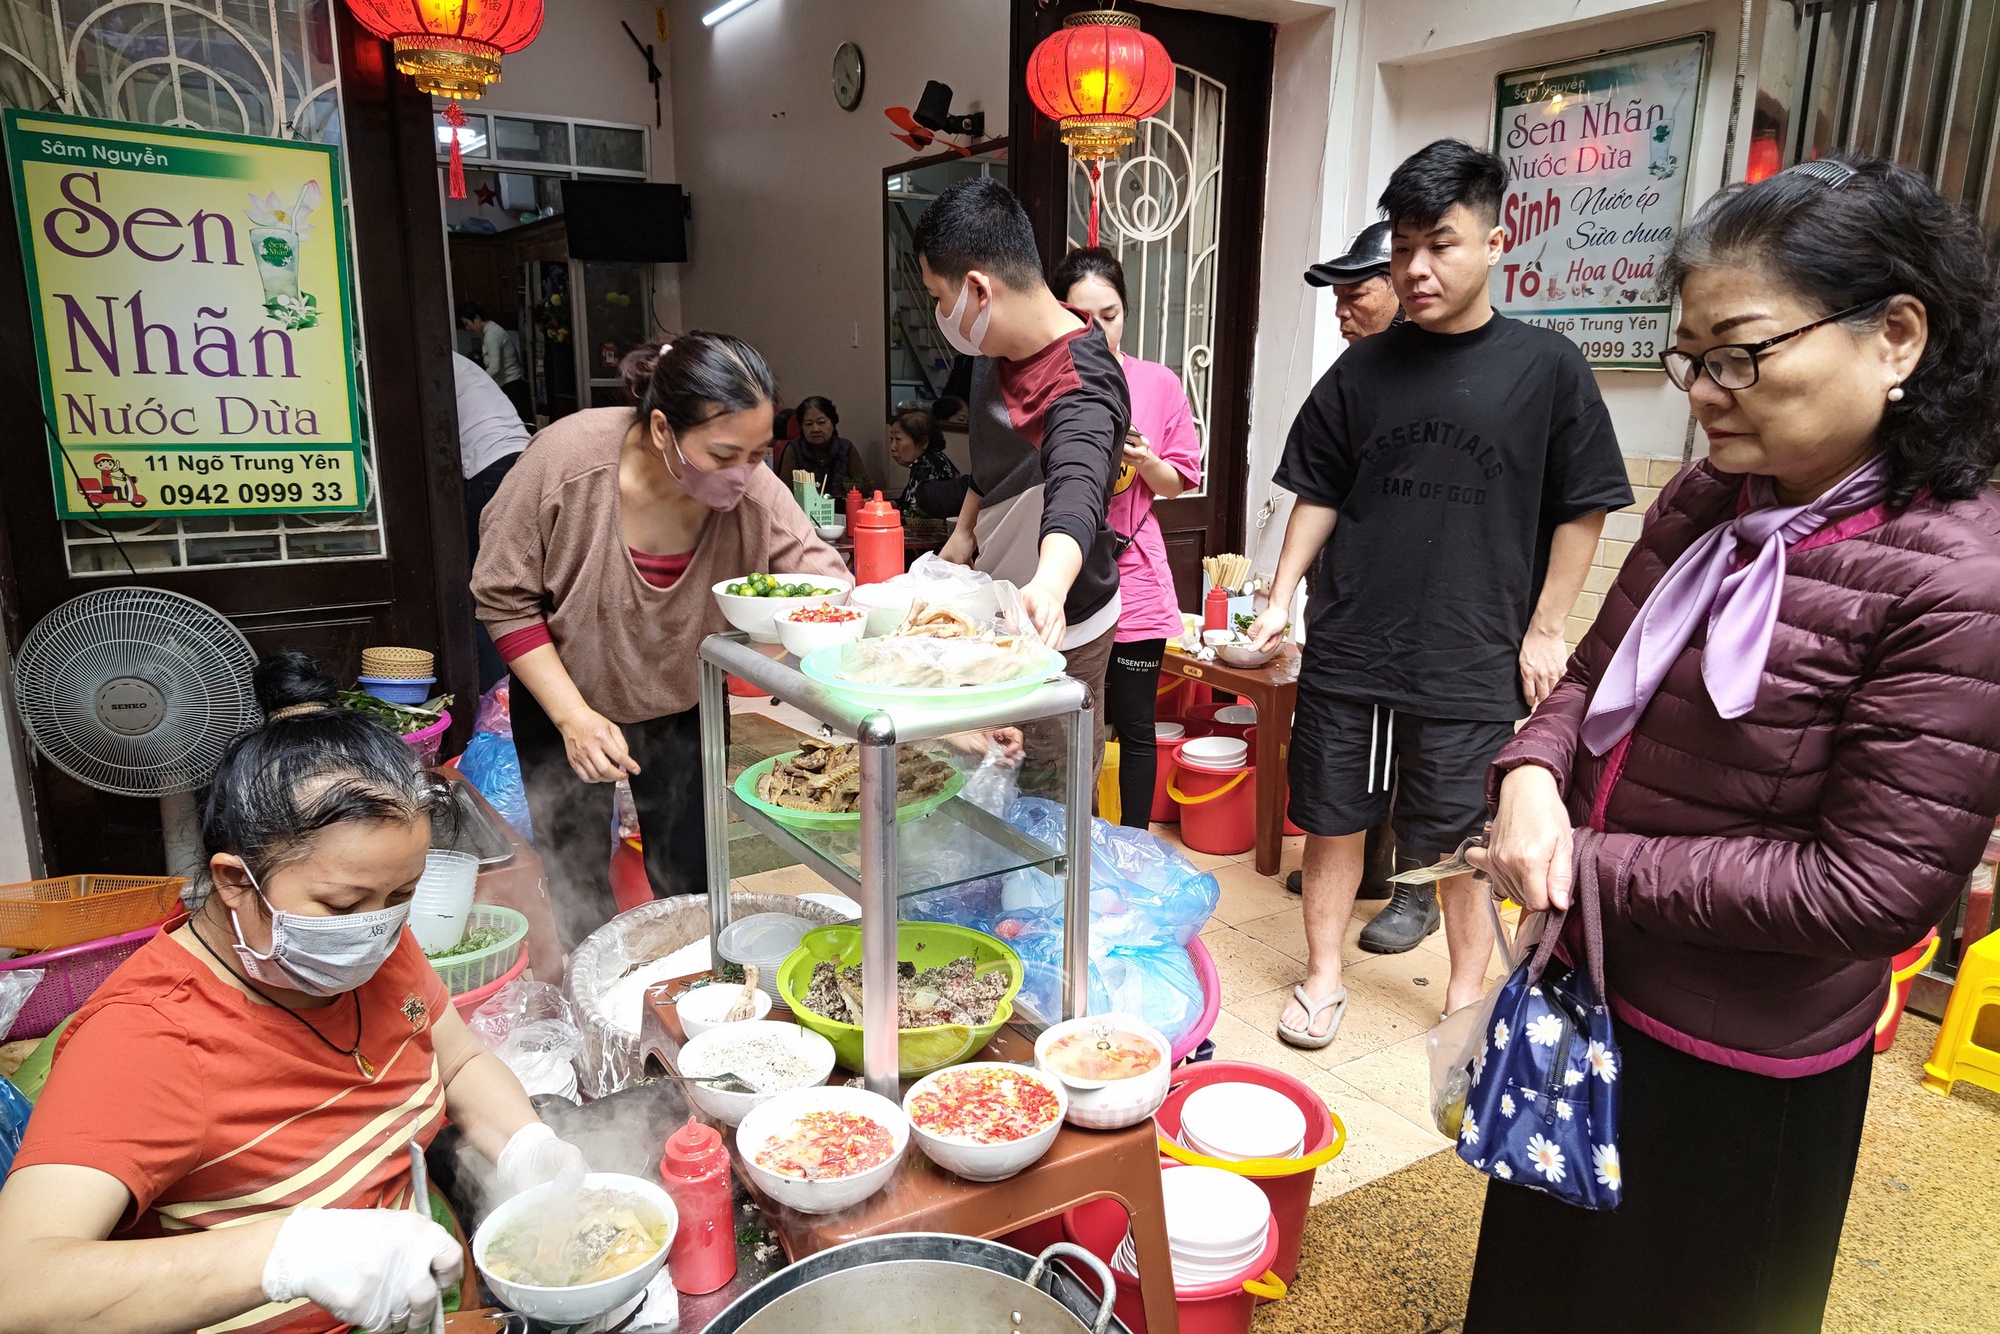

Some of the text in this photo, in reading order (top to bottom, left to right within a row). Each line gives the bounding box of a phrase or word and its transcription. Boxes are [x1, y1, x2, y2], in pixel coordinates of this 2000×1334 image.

[1507, 98, 1664, 149] Sen Nhãn
[41, 139, 168, 167] Sâm Nguyễn
[1508, 145, 1631, 181] Nước Dừa
[1571, 186, 1660, 215] Nước ép
[43, 172, 244, 266] Sen
[1503, 188, 1561, 254] Sinh
[1566, 221, 1674, 250] Sữa chua
[1566, 254, 1655, 285] Hoa Quả
[53, 289, 301, 379] Nhãn
[1547, 318, 1575, 334] Ngõ
[1580, 317, 1623, 333] Trung
[1629, 316, 1658, 330] Yên
[1580, 341, 1654, 358] 0999 33
[61, 393, 321, 436] Nước Dừa
[145, 454, 340, 476] 11 Ngõ Trung Yên
[1361, 421, 1503, 481] ESSENTIALS
[160, 481, 343, 506] 0942 0999 33
[1418, 481, 1444, 500] OF
[1448, 485, 1487, 505] GOD
[1117, 656, 1160, 668] ESSENTIALS
